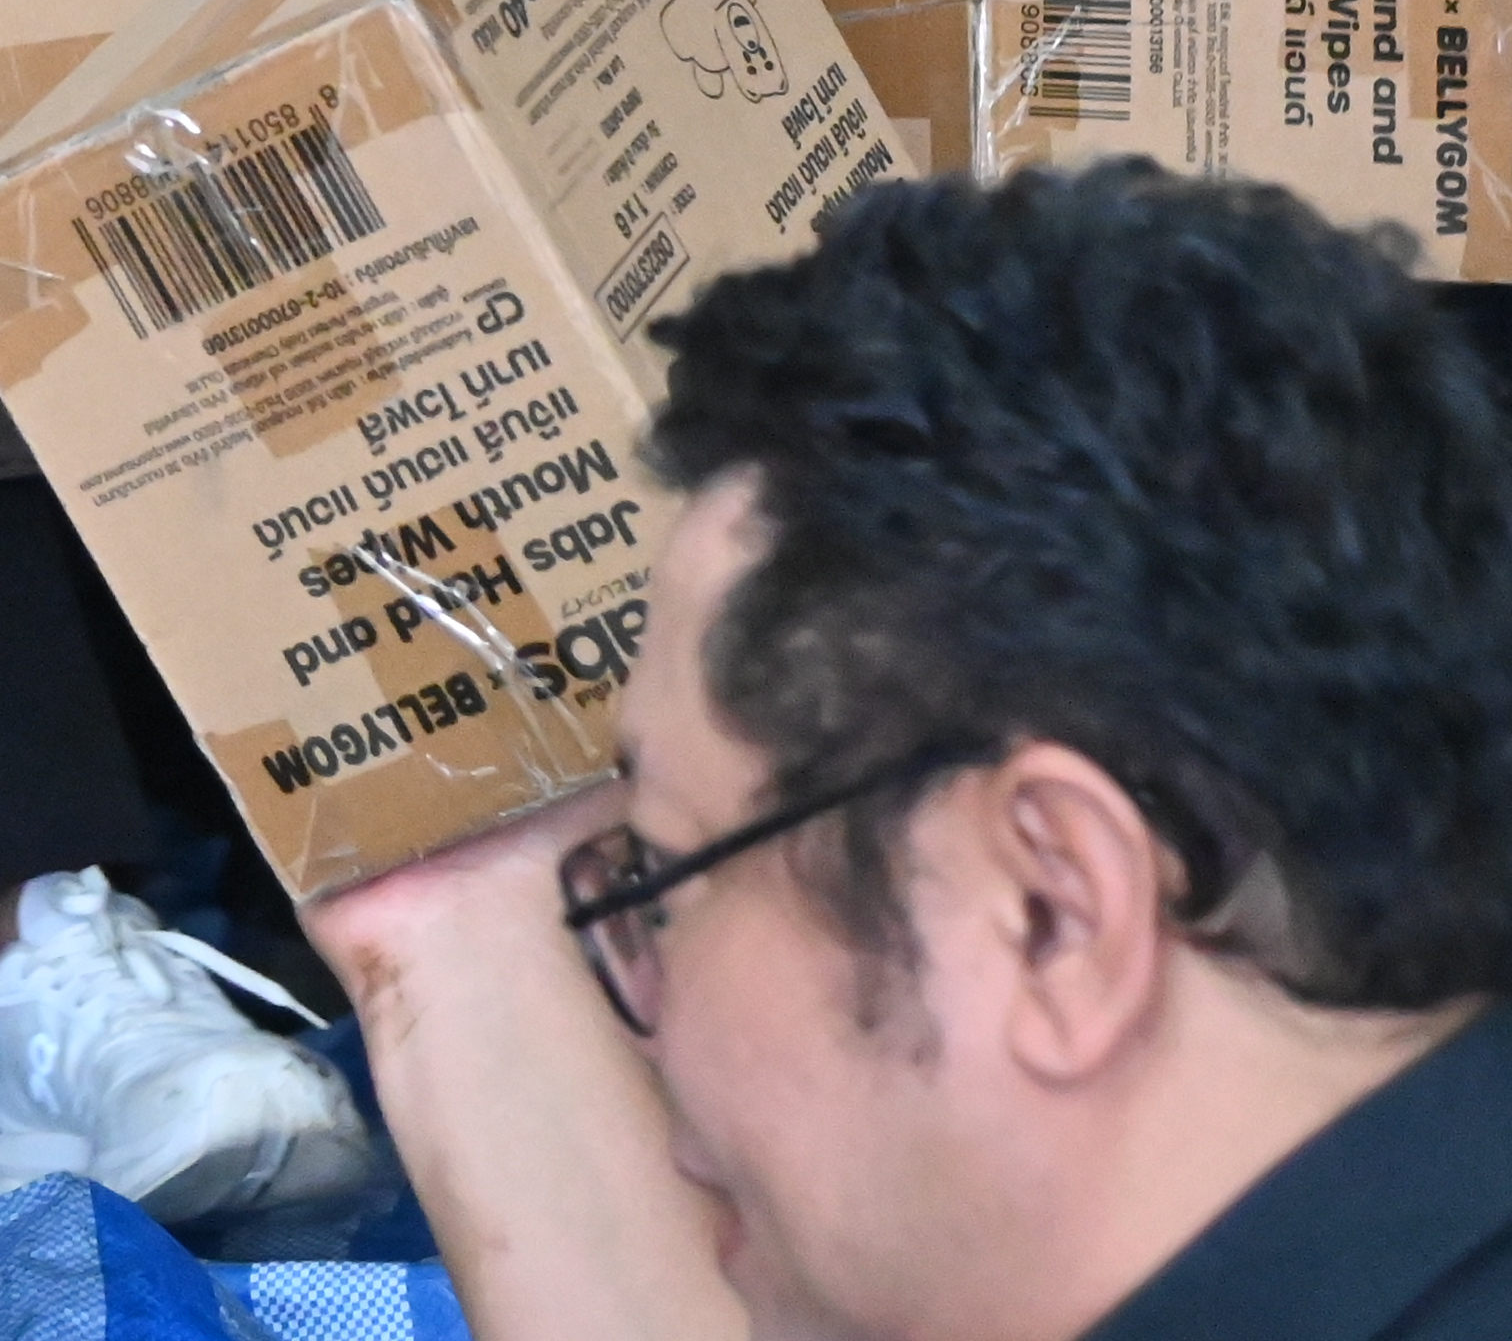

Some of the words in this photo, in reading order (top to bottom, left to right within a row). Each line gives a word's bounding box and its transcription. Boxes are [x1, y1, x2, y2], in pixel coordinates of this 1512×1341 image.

[1285, 28, 1313, 126] แอนด์
[1373, 78, 1403, 165] and
[204, 103, 300, 168] 850114
[1436, 27, 1468, 235] BELLYGOM
[466, 286, 531, 338] CP
[453, 440, 618, 532] Mouth
[289, 502, 457, 612] Wipes
[517, 493, 655, 583] Jabs
[283, 617, 377, 687] and
[262, 675, 486, 794] BELLYGOM
